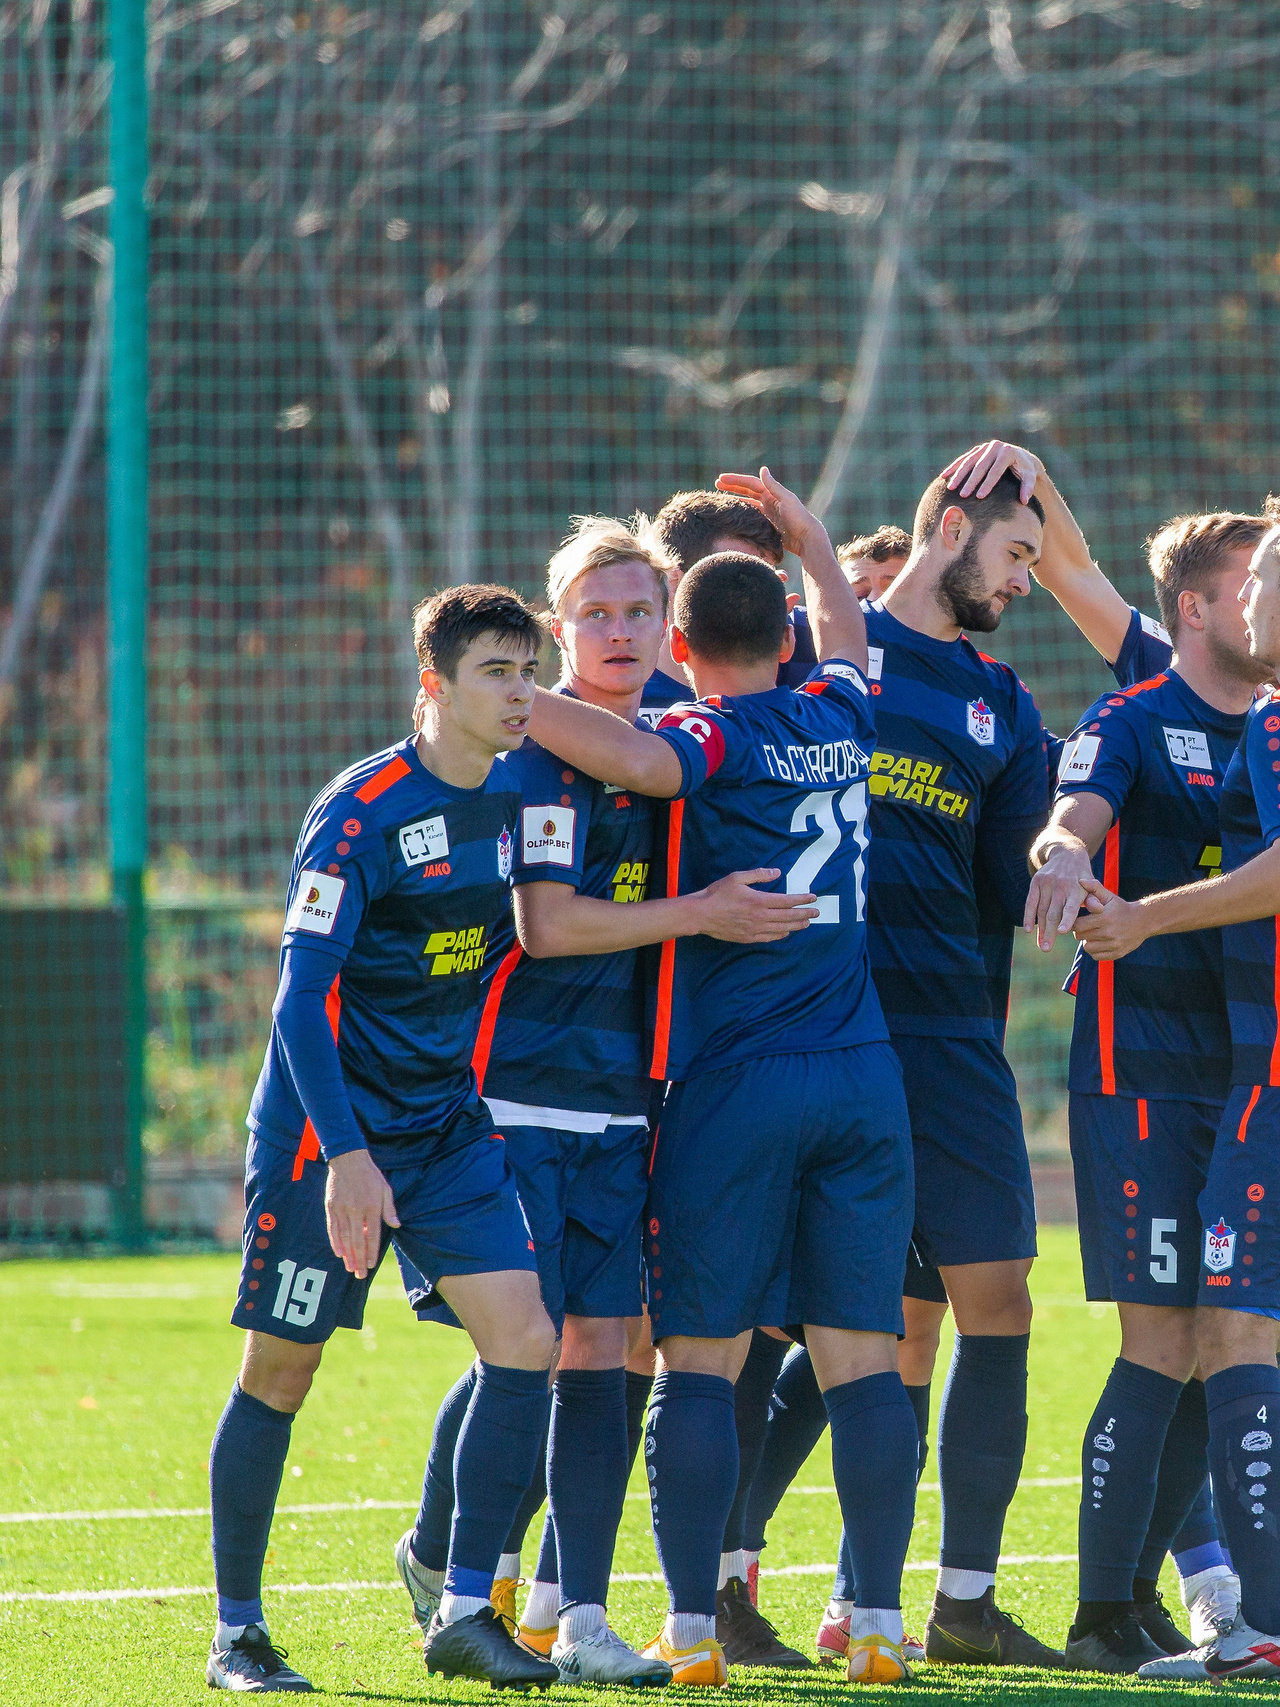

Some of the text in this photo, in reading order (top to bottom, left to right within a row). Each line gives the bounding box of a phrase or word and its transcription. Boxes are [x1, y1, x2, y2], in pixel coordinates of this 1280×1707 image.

[869, 752, 942, 786] PARI
[1187, 772, 1215, 787] JAKO
[868, 774, 968, 818] MATCH
[526, 839, 571, 850] OLIMP.BET
[786, 781, 869, 924] 21
[423, 863, 452, 878] JAKO
[424, 926, 484, 954] PARI
[1150, 1218, 1177, 1284] 5
[1206, 1275, 1231, 1287] JAKO
[272, 1259, 328, 1328] 19
[1104, 1417, 1116, 1434] 5
[1257, 1405, 1268, 1424] 4
